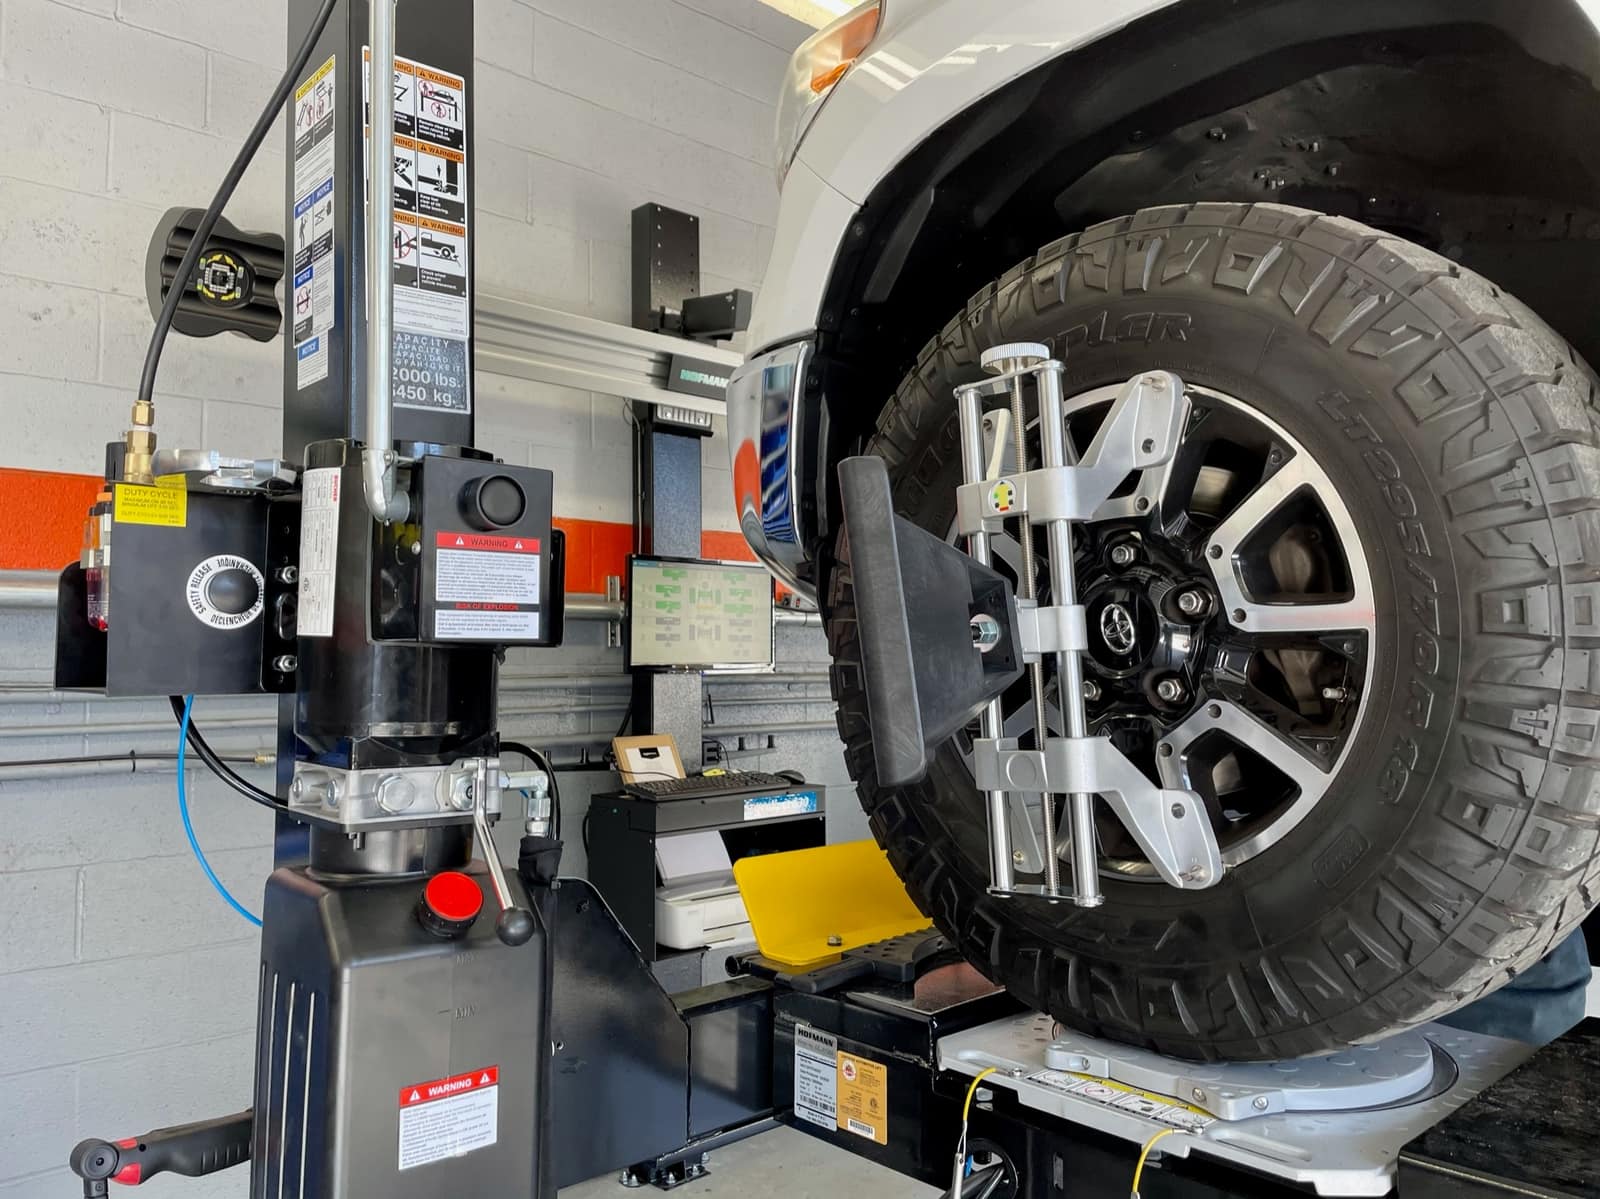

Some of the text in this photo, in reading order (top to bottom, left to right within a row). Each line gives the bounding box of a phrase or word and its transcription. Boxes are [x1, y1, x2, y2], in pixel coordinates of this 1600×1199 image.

[429, 73, 461, 88] WARNING
[429, 147, 461, 161] WARNING
[430, 221, 463, 235] WARNING
[395, 333, 449, 349] APACITY
[395, 350, 449, 363] APACIDAD
[393, 367, 461, 388] 2000 lbs.
[680, 369, 729, 388] HOFMAN
[393, 383, 456, 407] 450 kg.
[124, 487, 177, 499] DUTY CYCLE
[471, 538, 508, 548] WARNING
[190, 563, 213, 615] SAFETY RELEASE
[798, 1028, 834, 1047] HOFMANN
[428, 1078, 472, 1097] WARNING
